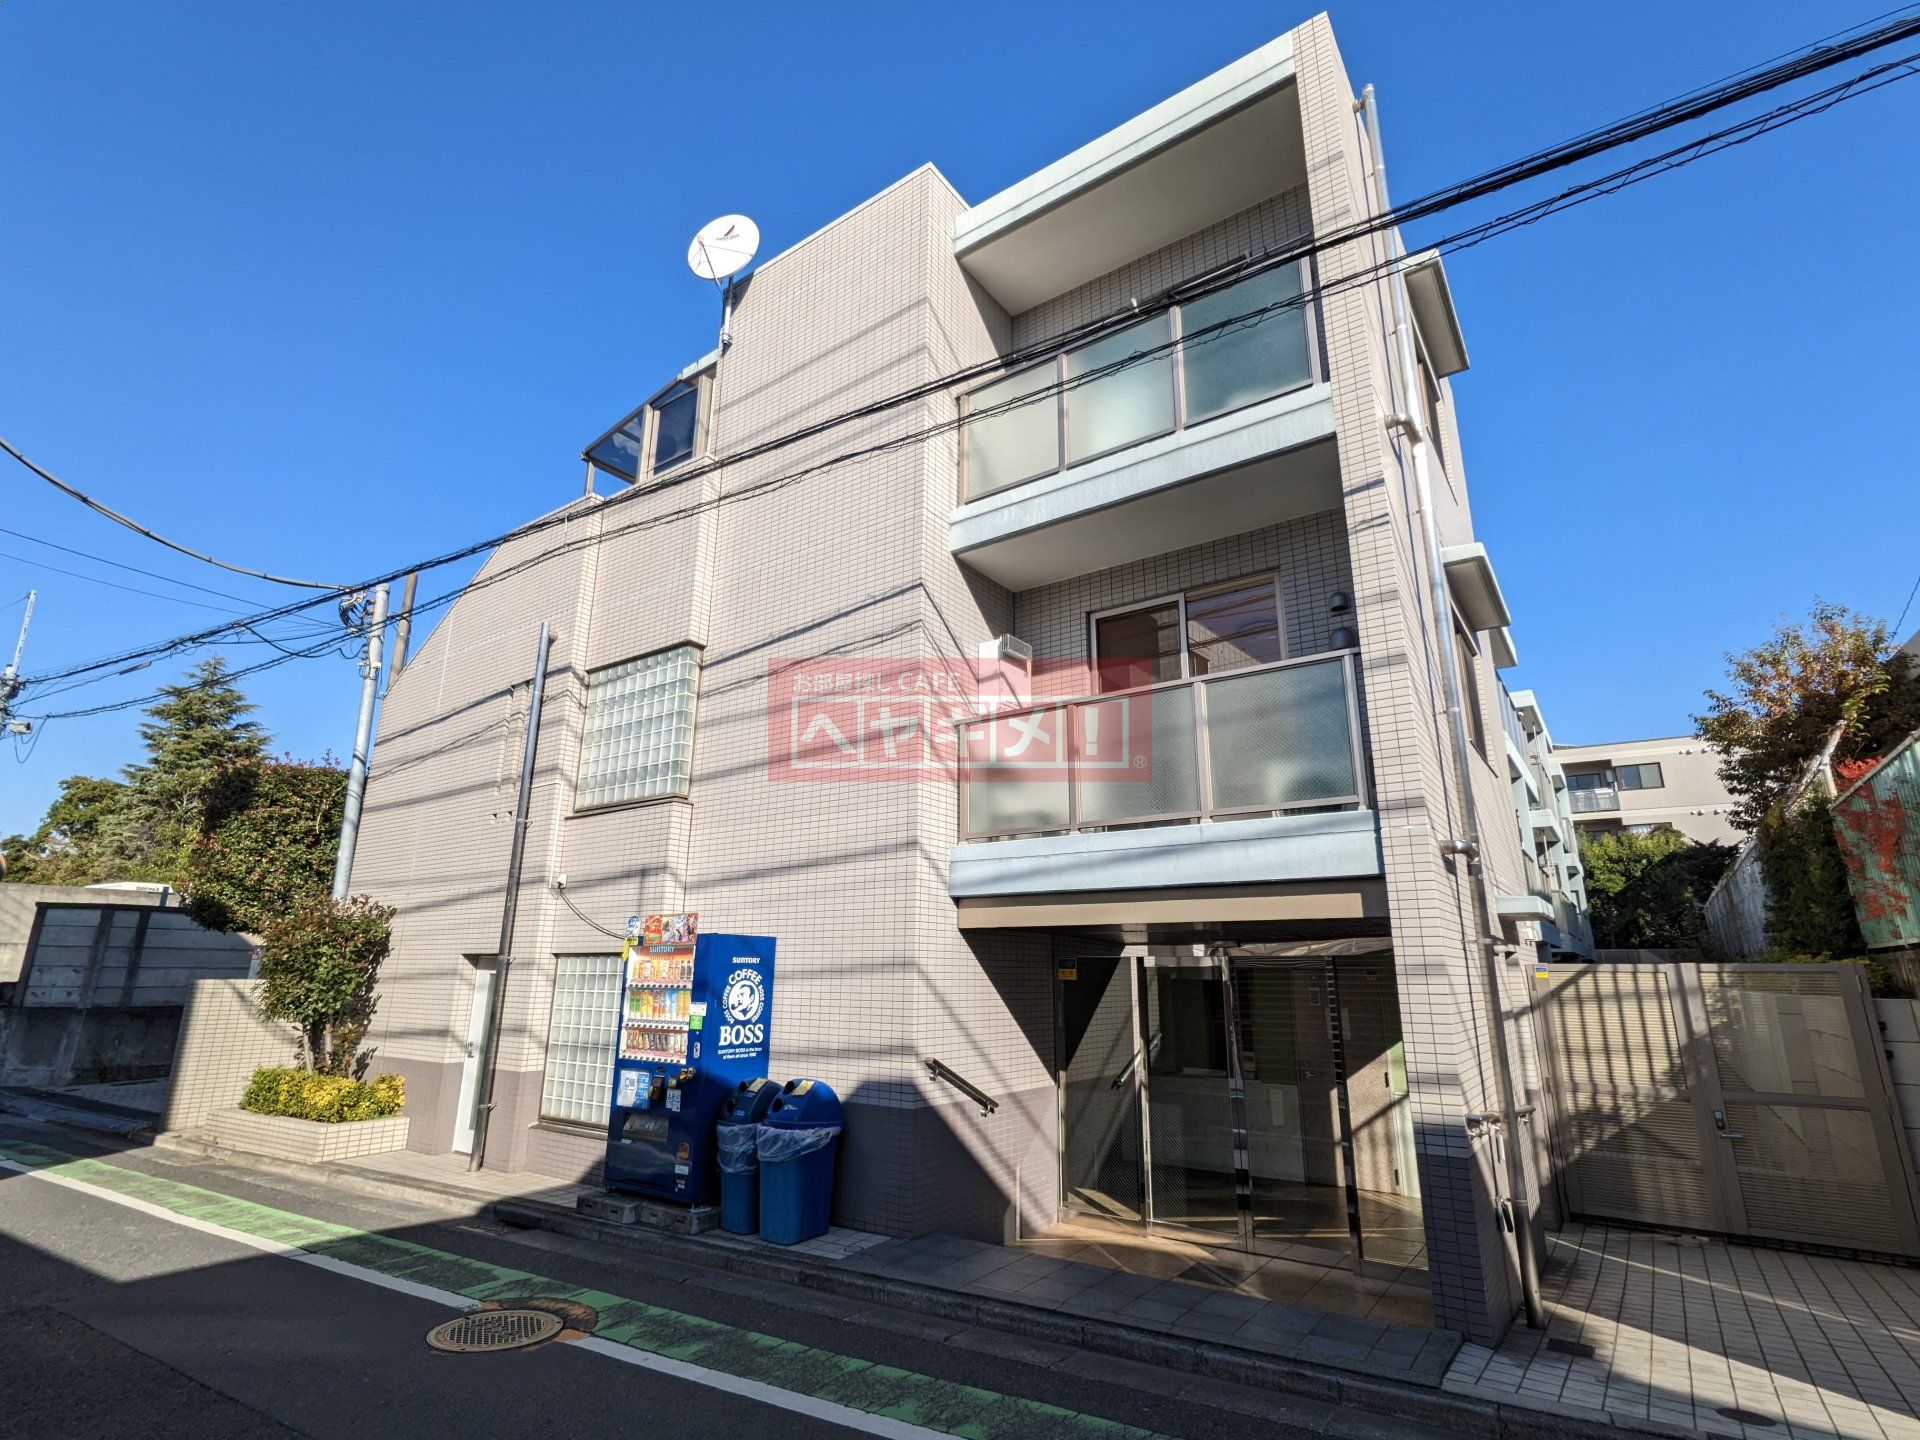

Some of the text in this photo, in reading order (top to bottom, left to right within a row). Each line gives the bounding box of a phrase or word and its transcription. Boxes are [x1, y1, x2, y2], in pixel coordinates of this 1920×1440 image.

[649, 945, 675, 953] SUNTORY
[732, 956, 761, 964] SUNTORY
[729, 969, 762, 985] COFFEE
[719, 1024, 764, 1046] BOSS
